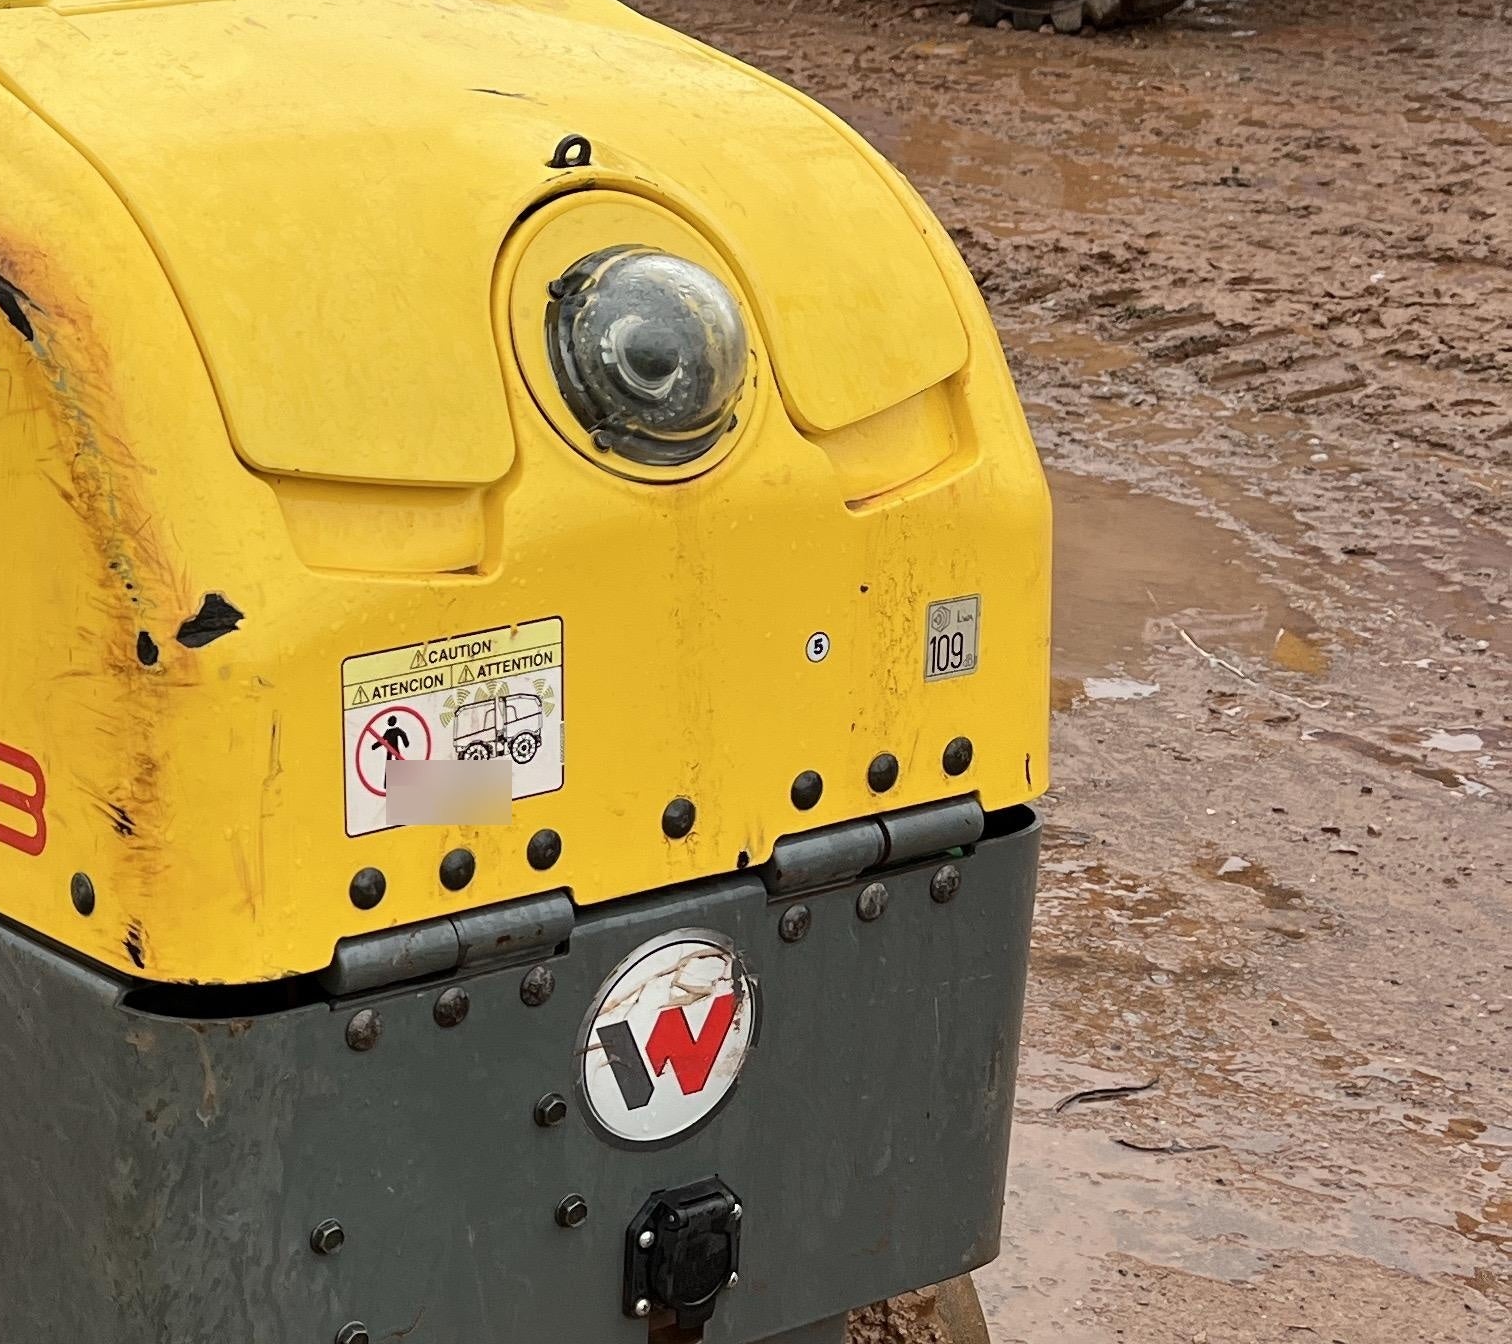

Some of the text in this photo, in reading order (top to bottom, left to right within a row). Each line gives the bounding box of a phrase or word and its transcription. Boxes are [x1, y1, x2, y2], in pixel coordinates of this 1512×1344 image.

[428, 640, 492, 664] CAUTION
[812, 637, 825, 656] 5
[929, 631, 964, 673] 109
[372, 673, 444, 701] ATENCION
